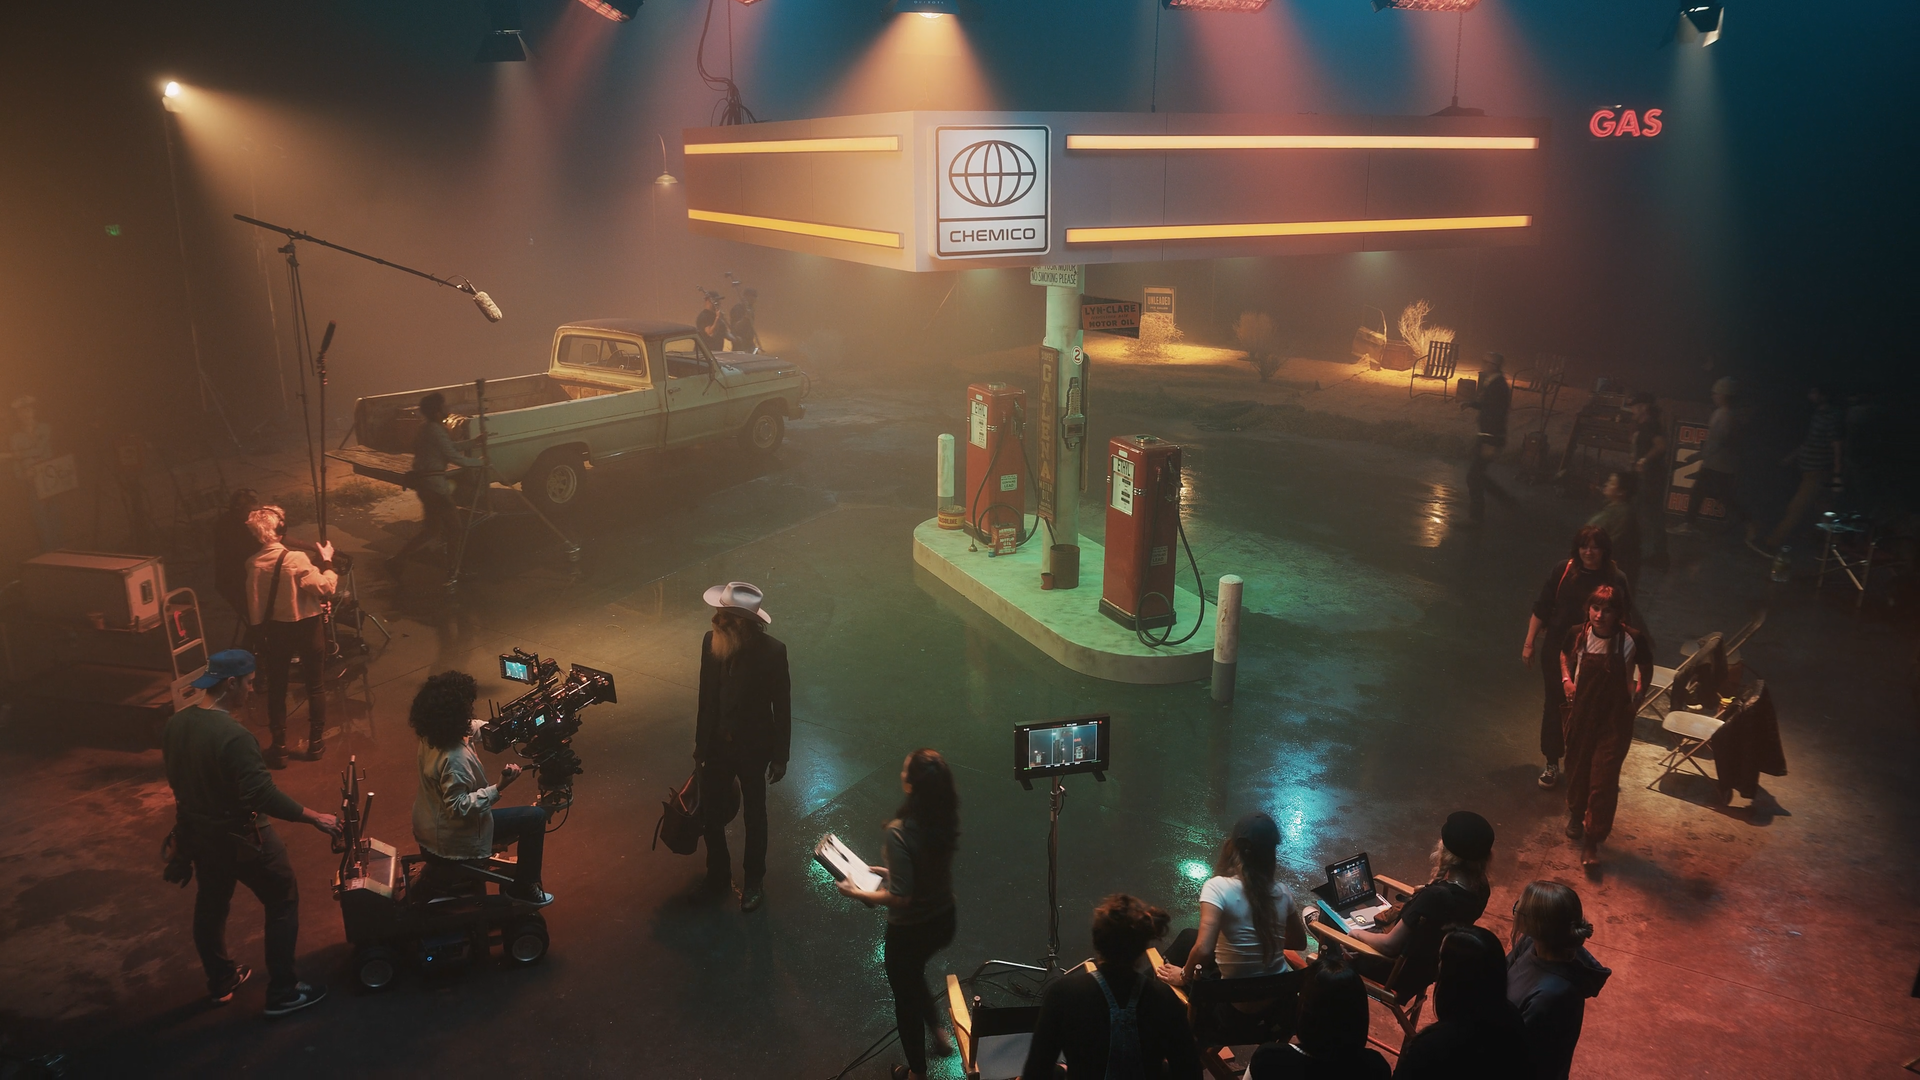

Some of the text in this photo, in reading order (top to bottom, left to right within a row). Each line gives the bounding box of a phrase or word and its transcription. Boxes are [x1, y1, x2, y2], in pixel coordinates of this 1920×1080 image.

[1589, 108, 1663, 137] GAS
[950, 228, 1036, 242] CHEMICO
[1032, 271, 1076, 285] NO SMOKING PLEASE
[1147, 296, 1171, 306] UNLEADED
[1089, 320, 1117, 328] MOTOR
[1074, 349, 1081, 361] 2
[1040, 363, 1052, 480] GALENA
